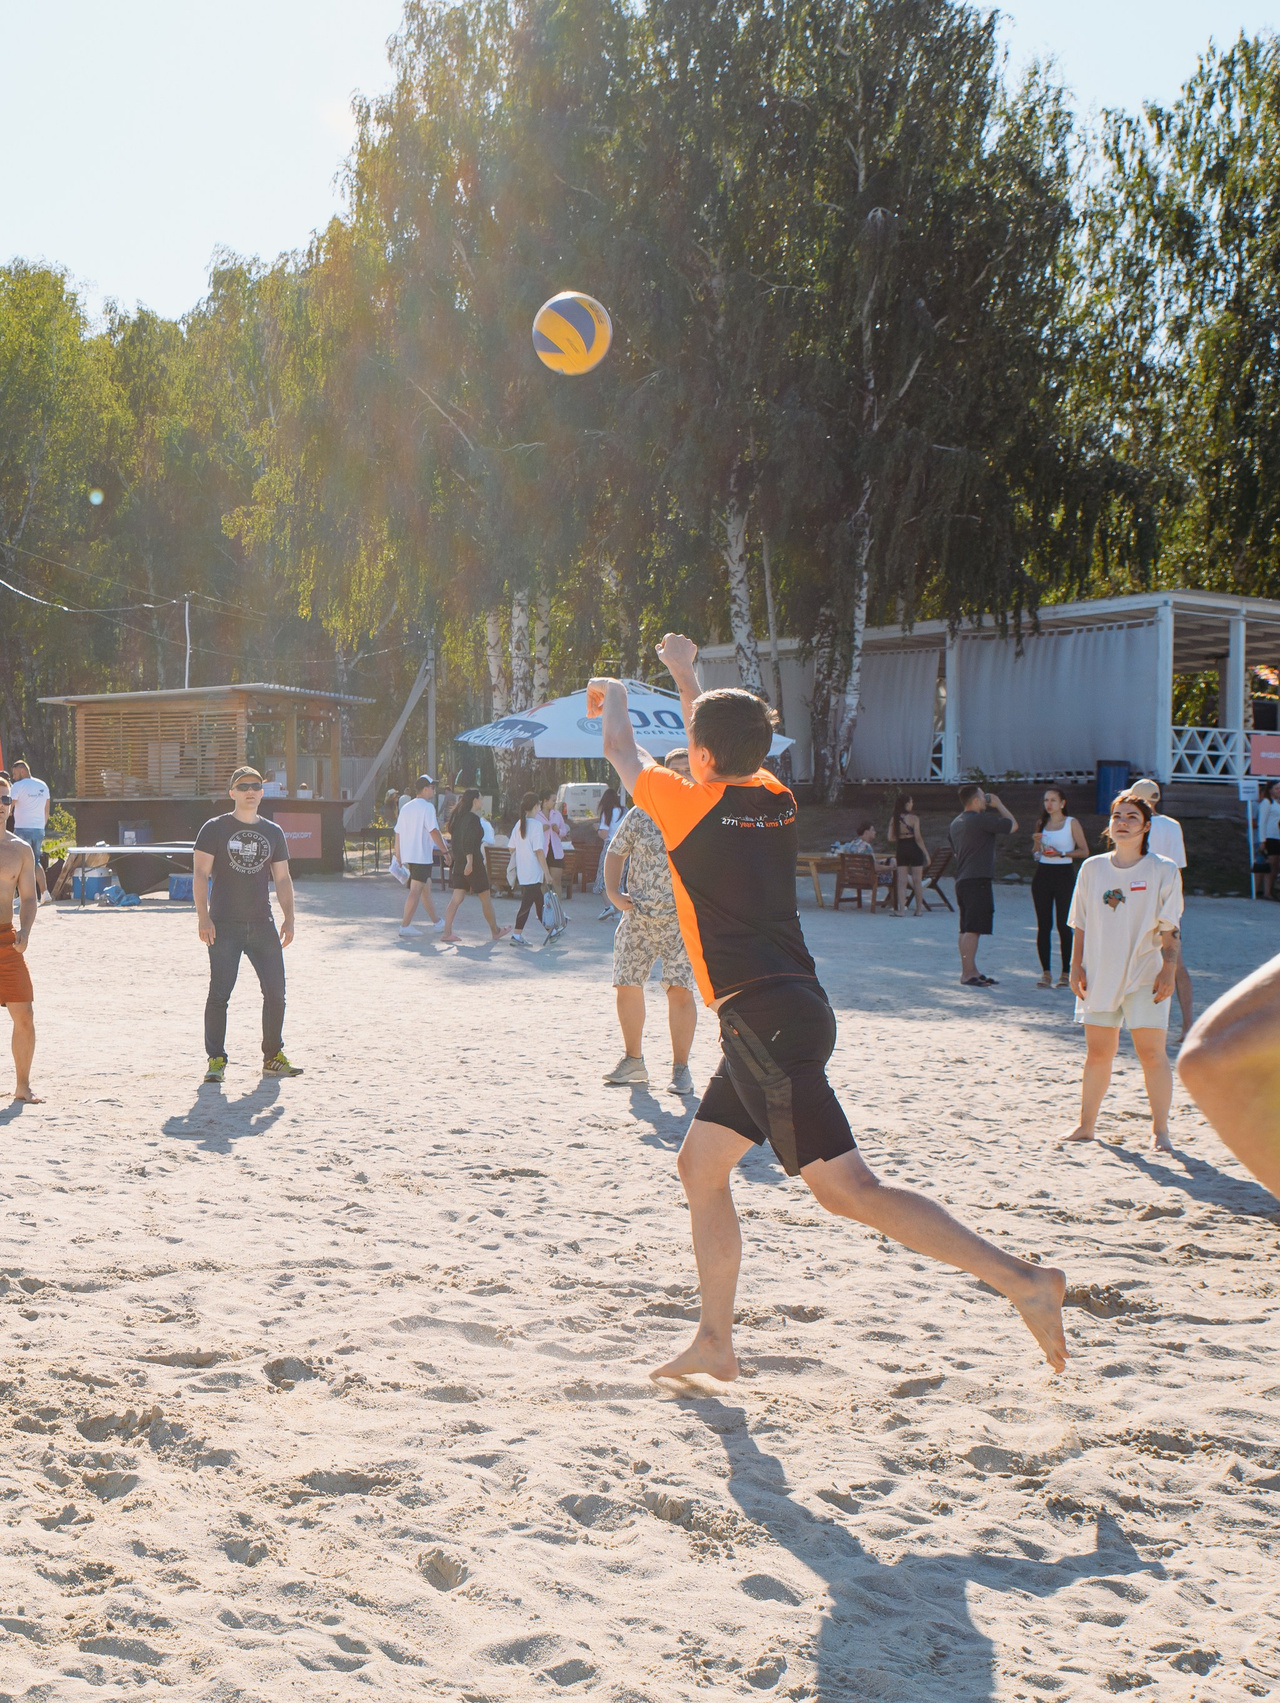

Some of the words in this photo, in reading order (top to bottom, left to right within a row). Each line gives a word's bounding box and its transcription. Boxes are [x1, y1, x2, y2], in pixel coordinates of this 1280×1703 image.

[721, 817, 738, 826] 2771
[242, 832, 269, 849] COOPER
[229, 861, 247, 874] DENIM
